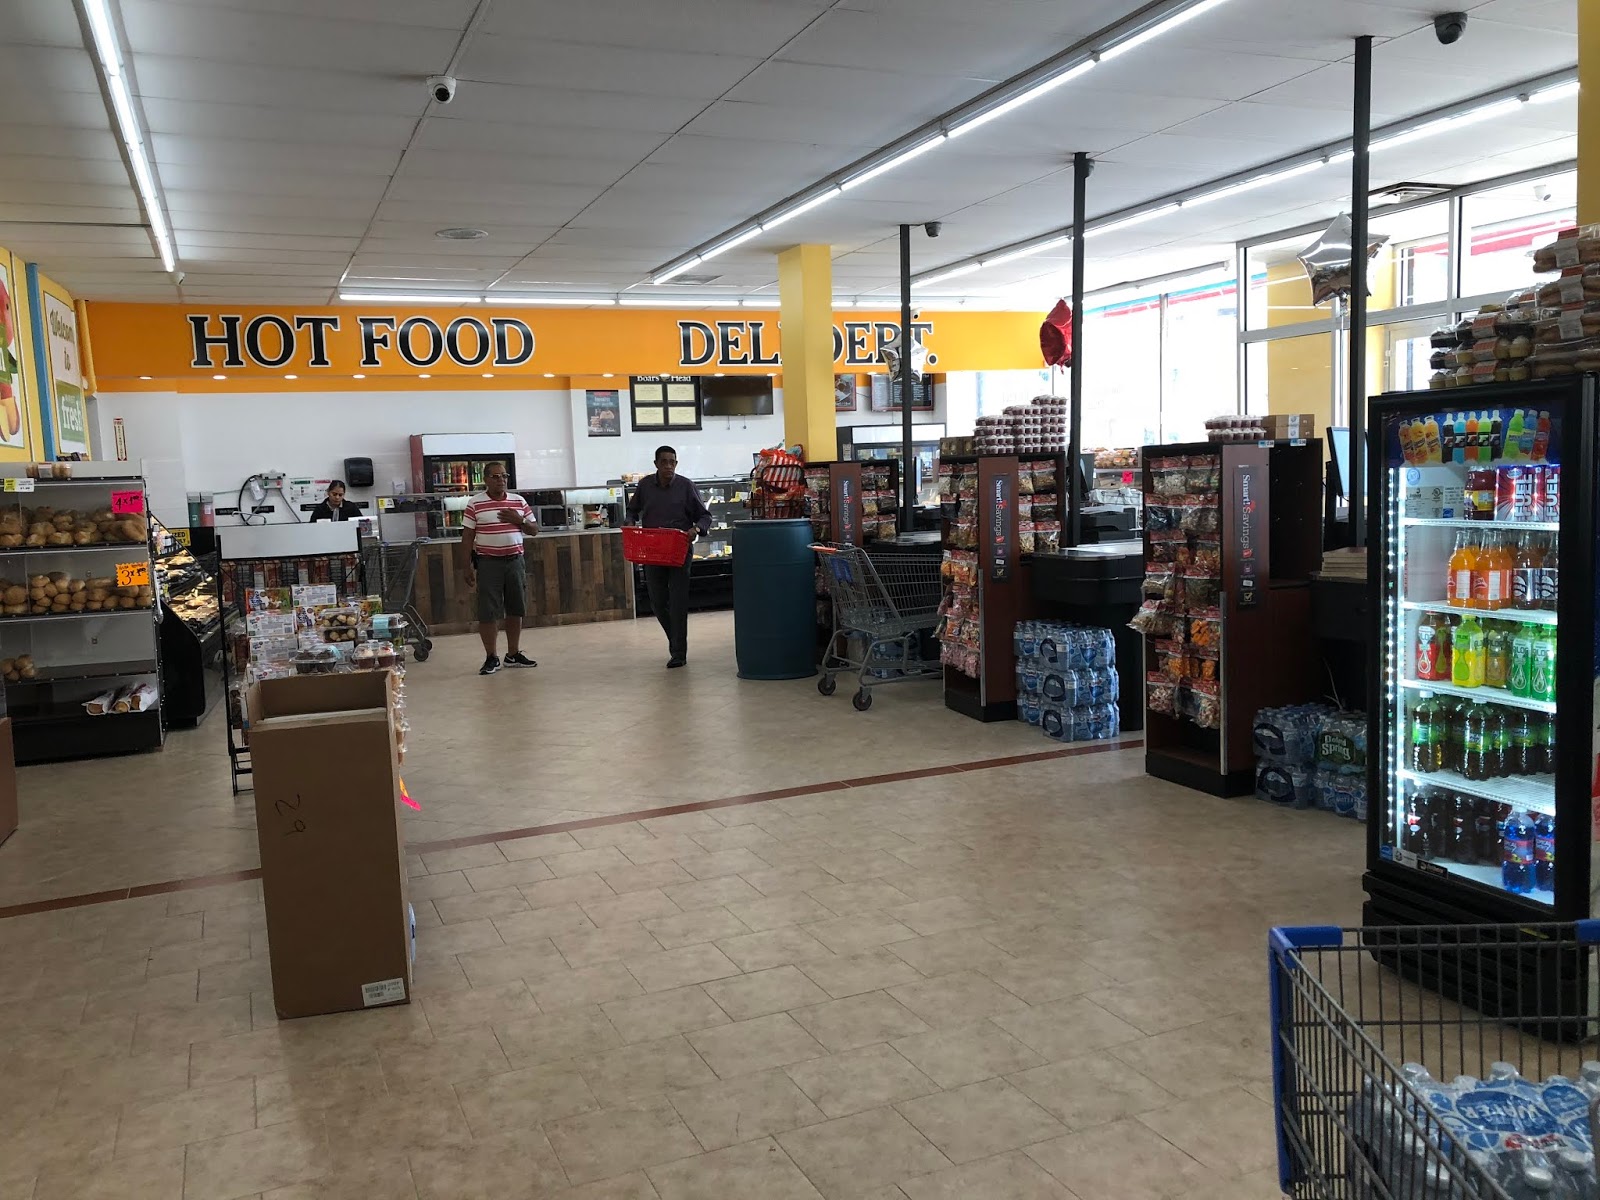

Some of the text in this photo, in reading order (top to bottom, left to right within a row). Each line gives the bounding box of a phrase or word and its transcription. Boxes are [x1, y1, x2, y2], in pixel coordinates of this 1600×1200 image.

[187, 314, 535, 368] HOT FOOD
[677, 320, 783, 367] DEL
[994, 480, 1003, 536] Smart! Savings
[1242, 474, 1251, 505] Smart!
[1514, 479, 1525, 517] FUEL
[1546, 473, 1558, 517] FUEL
[1241, 507, 1251, 549] Savings
[1321, 743, 1351, 760] Spring
[1459, 1102, 1542, 1120] WATER
